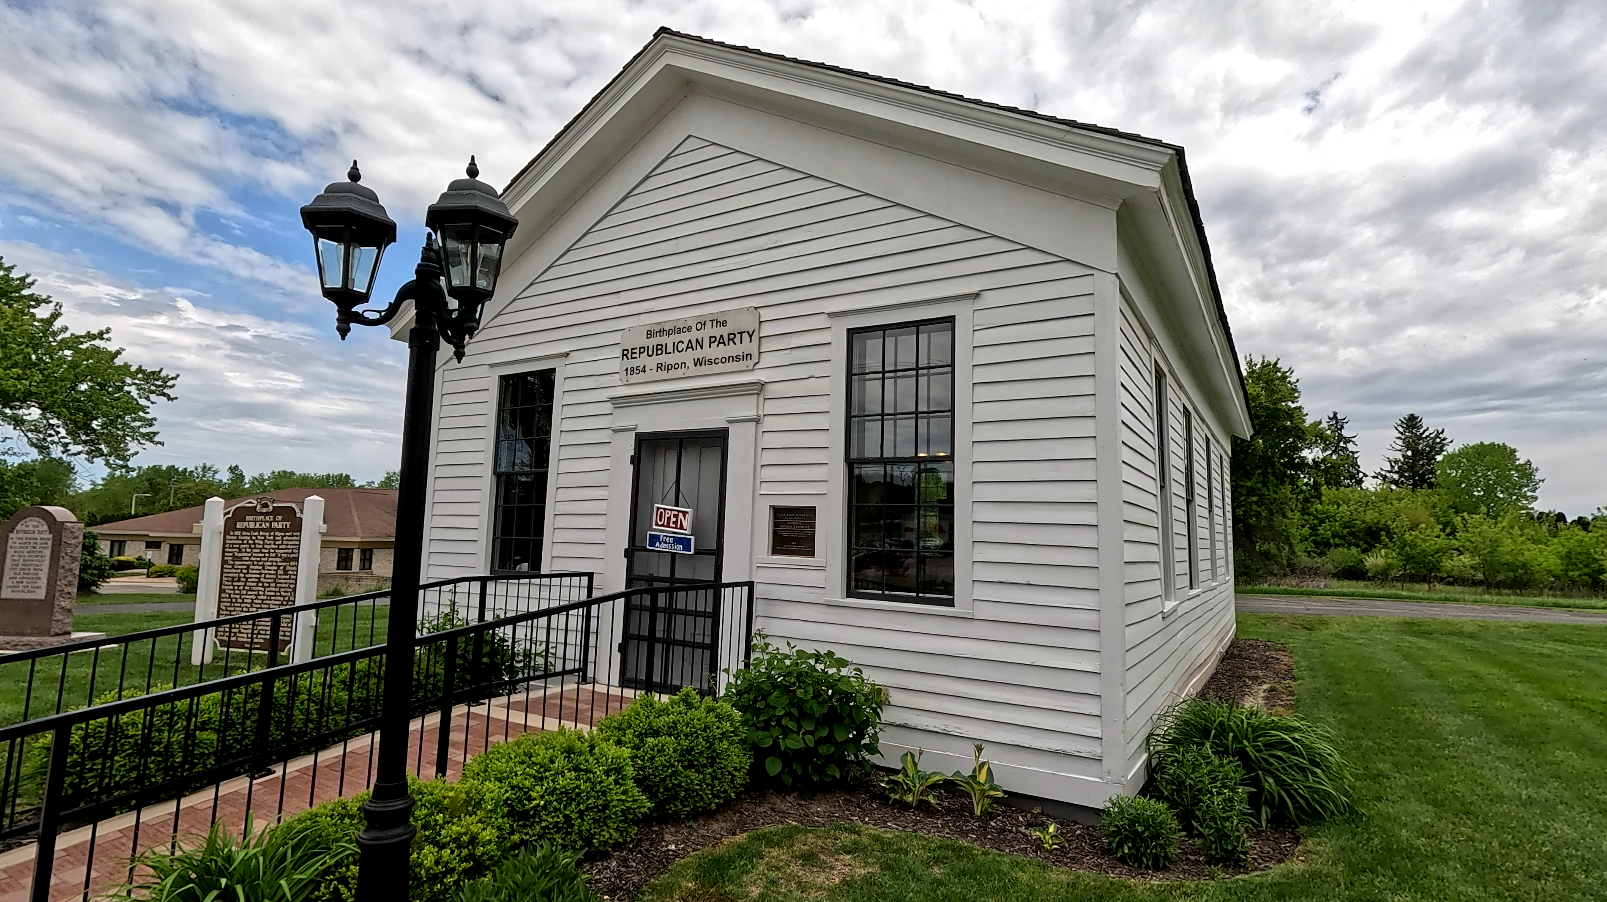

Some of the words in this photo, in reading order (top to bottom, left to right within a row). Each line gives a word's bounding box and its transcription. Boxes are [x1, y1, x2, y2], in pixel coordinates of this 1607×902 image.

[646, 325, 692, 339] Birthplace
[696, 320, 707, 331] Of
[710, 319, 727, 329] The
[622, 337, 704, 361] REPUBLICAN
[708, 329, 756, 349] PARTY
[624, 365, 646, 376] 1854
[656, 361, 690, 373] Ripon,
[693, 352, 752, 367] Wisconsin
[657, 509, 688, 529] OPEN
[655, 542, 682, 551] Admission
[660, 534, 673, 543] Free
